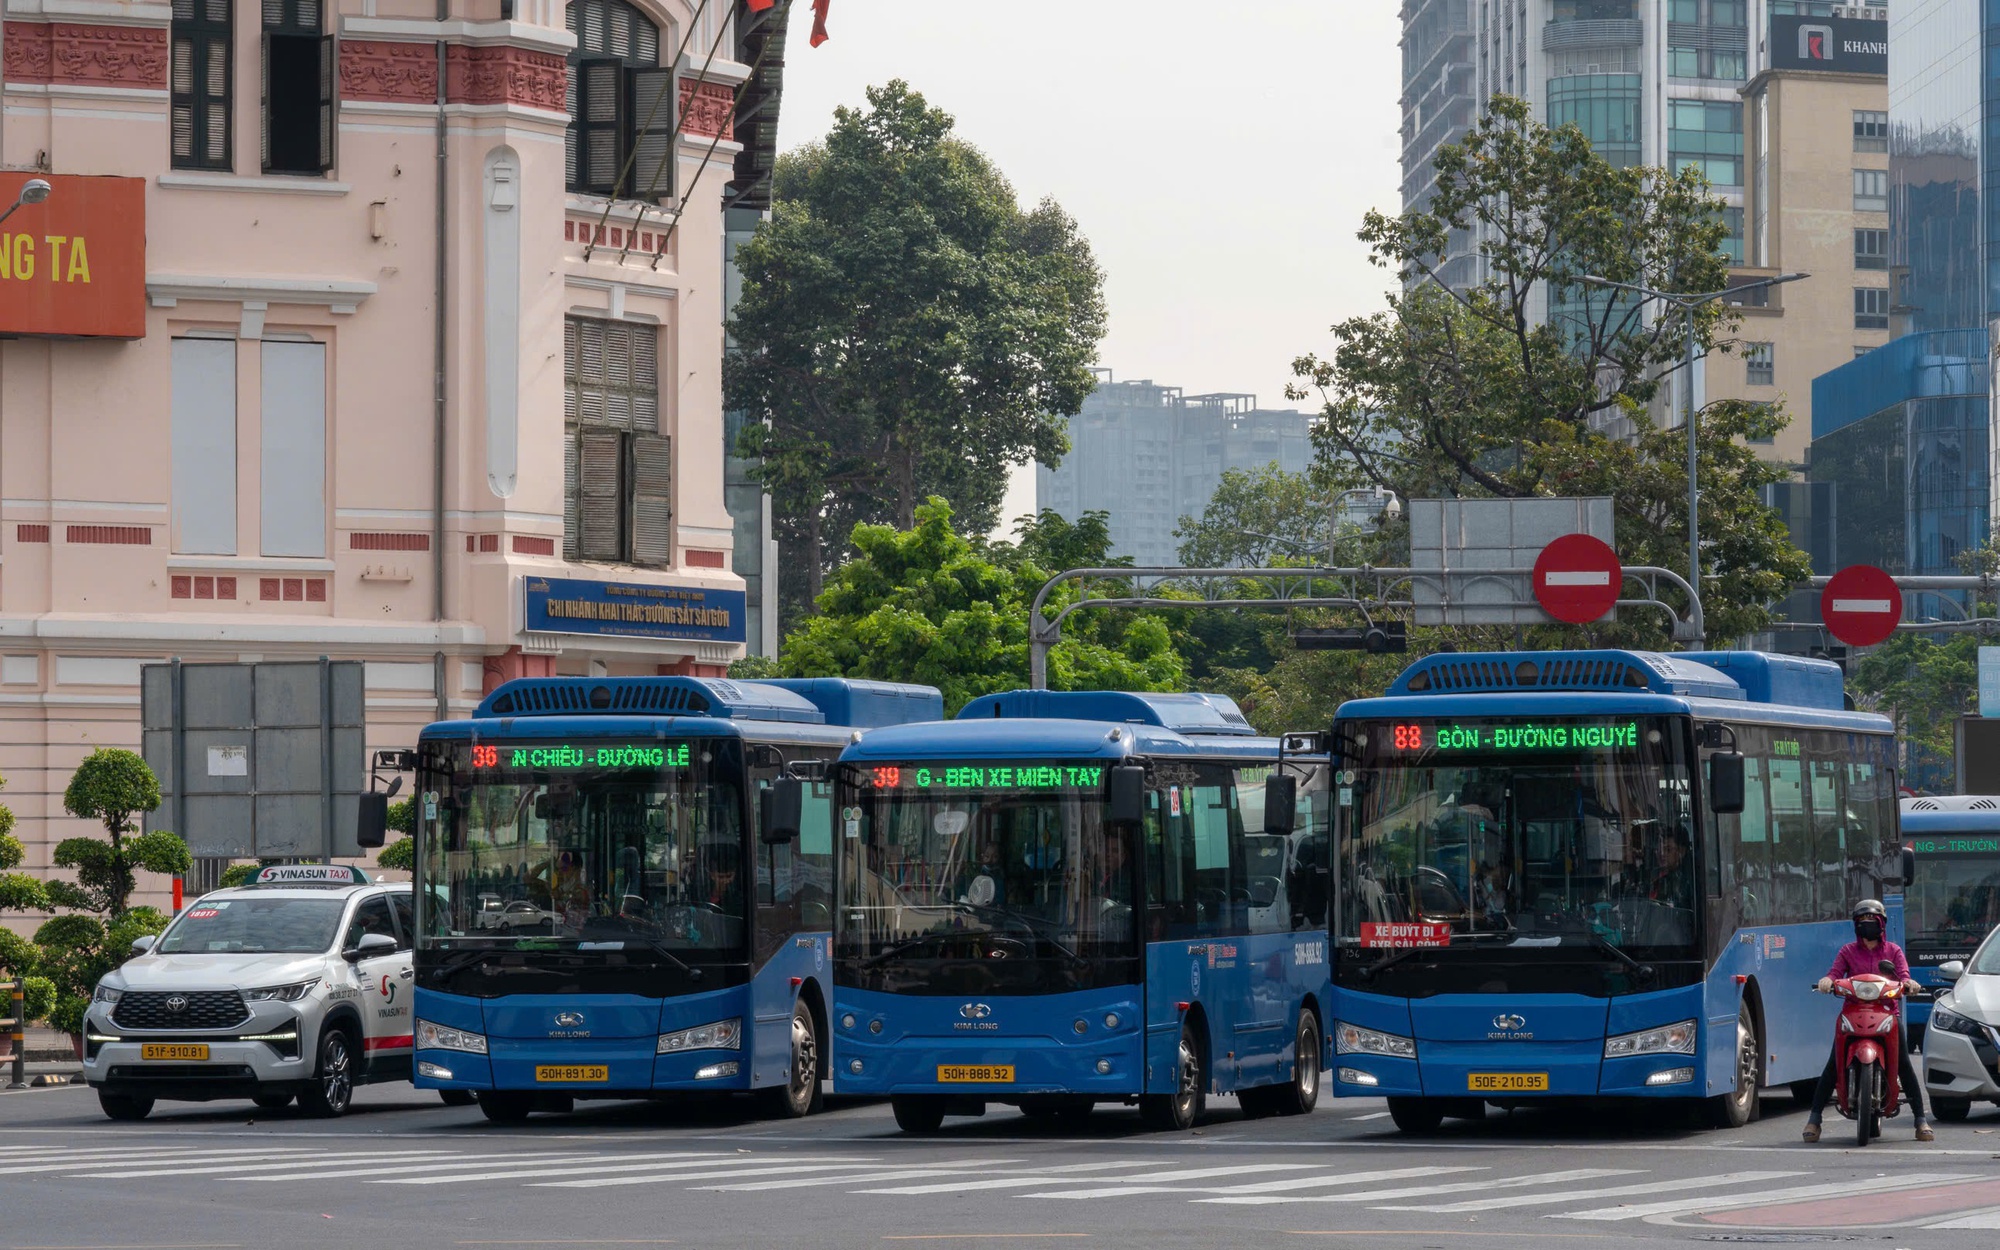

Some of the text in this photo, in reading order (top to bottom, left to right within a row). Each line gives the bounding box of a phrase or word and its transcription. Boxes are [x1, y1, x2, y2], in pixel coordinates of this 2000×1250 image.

[1844, 40, 1887, 54] KHANH
[45, 235, 91, 284] TA
[547, 599, 564, 617] CHI
[565, 597, 598, 619] NHÁNH
[598, 602, 620, 620] KHAI
[622, 601, 645, 622] THÁC
[1394, 725, 1422, 749] 88
[1437, 725, 1479, 748] GÒN
[1494, 724, 1567, 748] ĐƯỜNG
[472, 746, 498, 767] 36
[511, 750, 526, 766] N
[597, 744, 664, 766] ĐƯỜNG
[668, 744, 689, 766] LÊ
[873, 767, 900, 788] 39
[916, 770, 931, 787] G
[988, 768, 1012, 786] XE
[1915, 842, 1935, 852] NG
[280, 869, 350, 880] VINASUN TAXI
[1375, 924, 1434, 937] XE BUÝT ĐI
[378, 1008, 400, 1018] VINASUN
[953, 1022, 998, 1030] KIM LONG
[548, 1030, 591, 1038] KIM LONG
[1488, 1032, 1534, 1040] KIM LONG
[147, 1046, 202, 1057] 51F-910.81
[540, 1069, 603, 1080] 50H-891.30
[944, 1068, 1008, 1080] 50H-888.92
[1474, 1076, 1542, 1088] 50E-210.95
